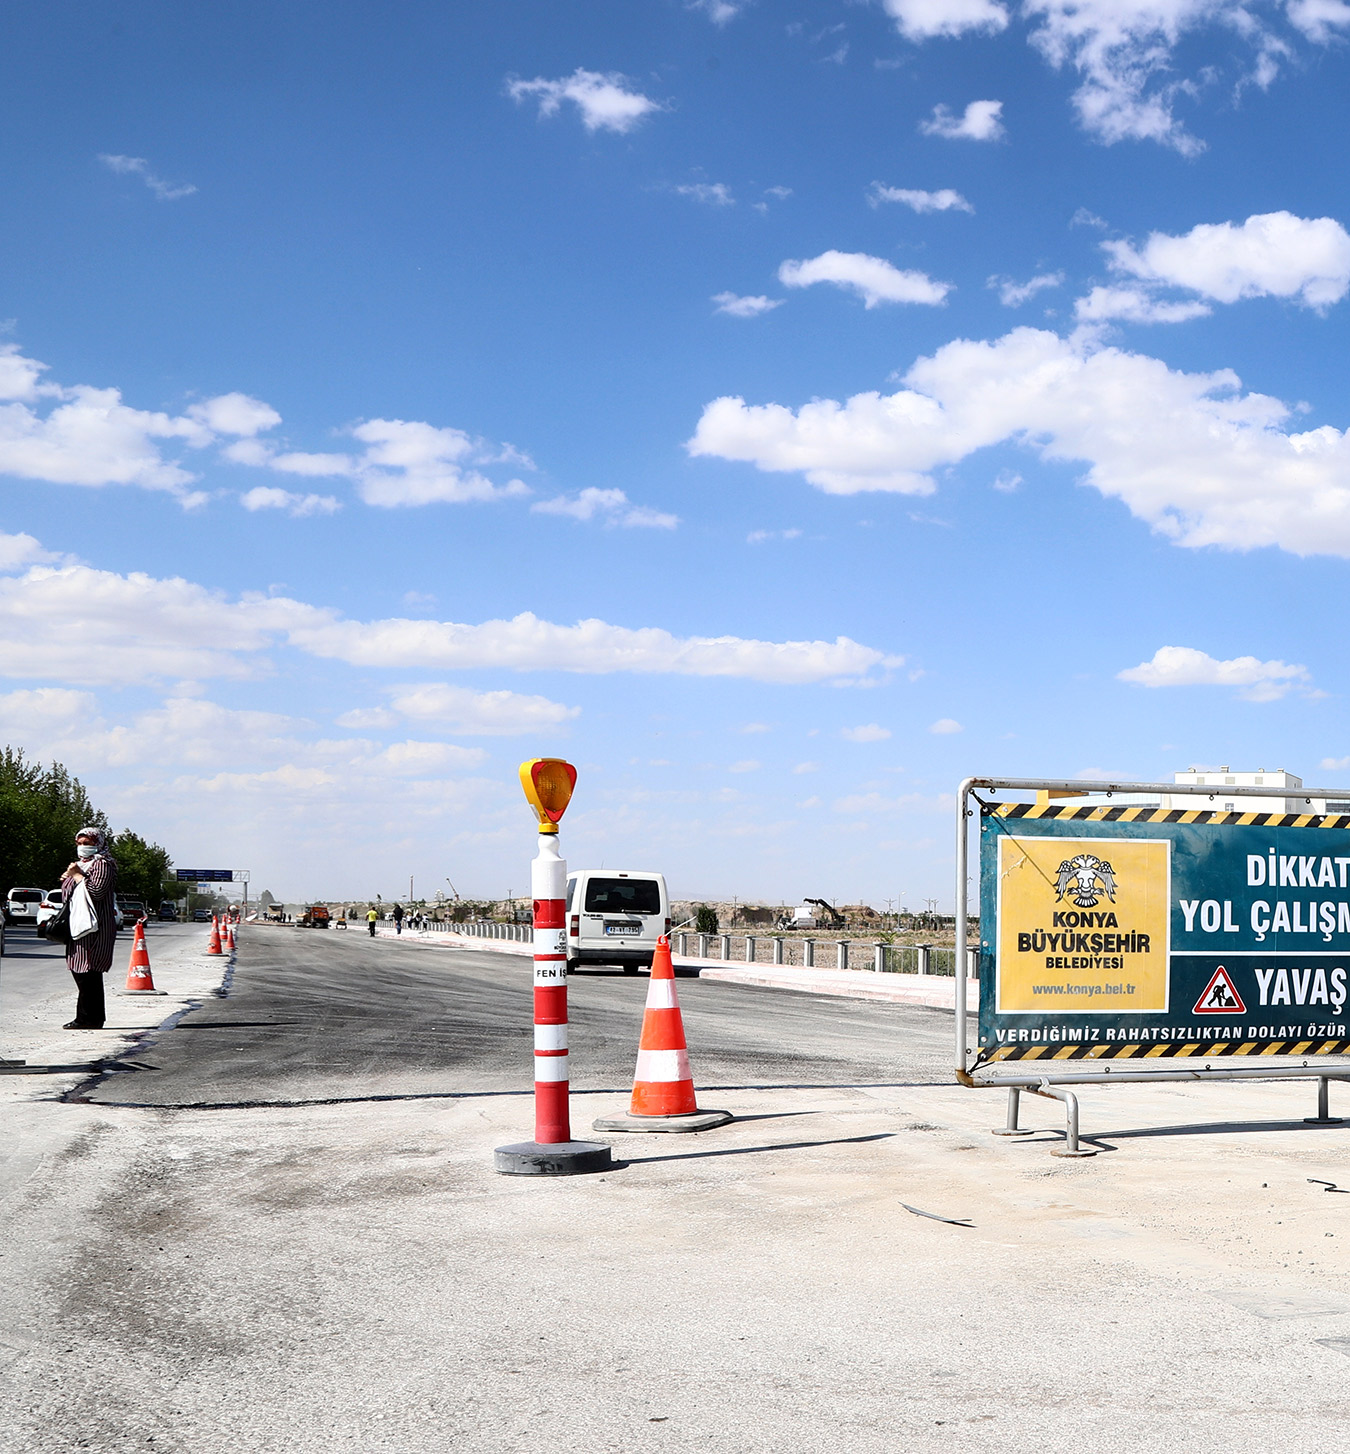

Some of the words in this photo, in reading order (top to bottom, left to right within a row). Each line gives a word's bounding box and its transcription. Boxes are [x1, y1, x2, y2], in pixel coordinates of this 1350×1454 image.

[1053, 911, 1118, 928] KONYA
[1179, 899, 1239, 933] YOL
[1018, 928, 1150, 956] BÜYÜKŞEHİR
[1046, 954, 1124, 969] BELEDİYESİ
[536, 969, 556, 978] FEN
[1032, 983, 1136, 997] www.konya.bel.tr
[1254, 967, 1347, 1015] YAVAŞ
[995, 1025, 1100, 1042] VERDİĞİMİZ
[1106, 1026, 1242, 1041] RAHATSIZLIKTAN
[1247, 1025, 1301, 1038] DOLAYI
[1307, 1022, 1346, 1037] ÖZÜR
